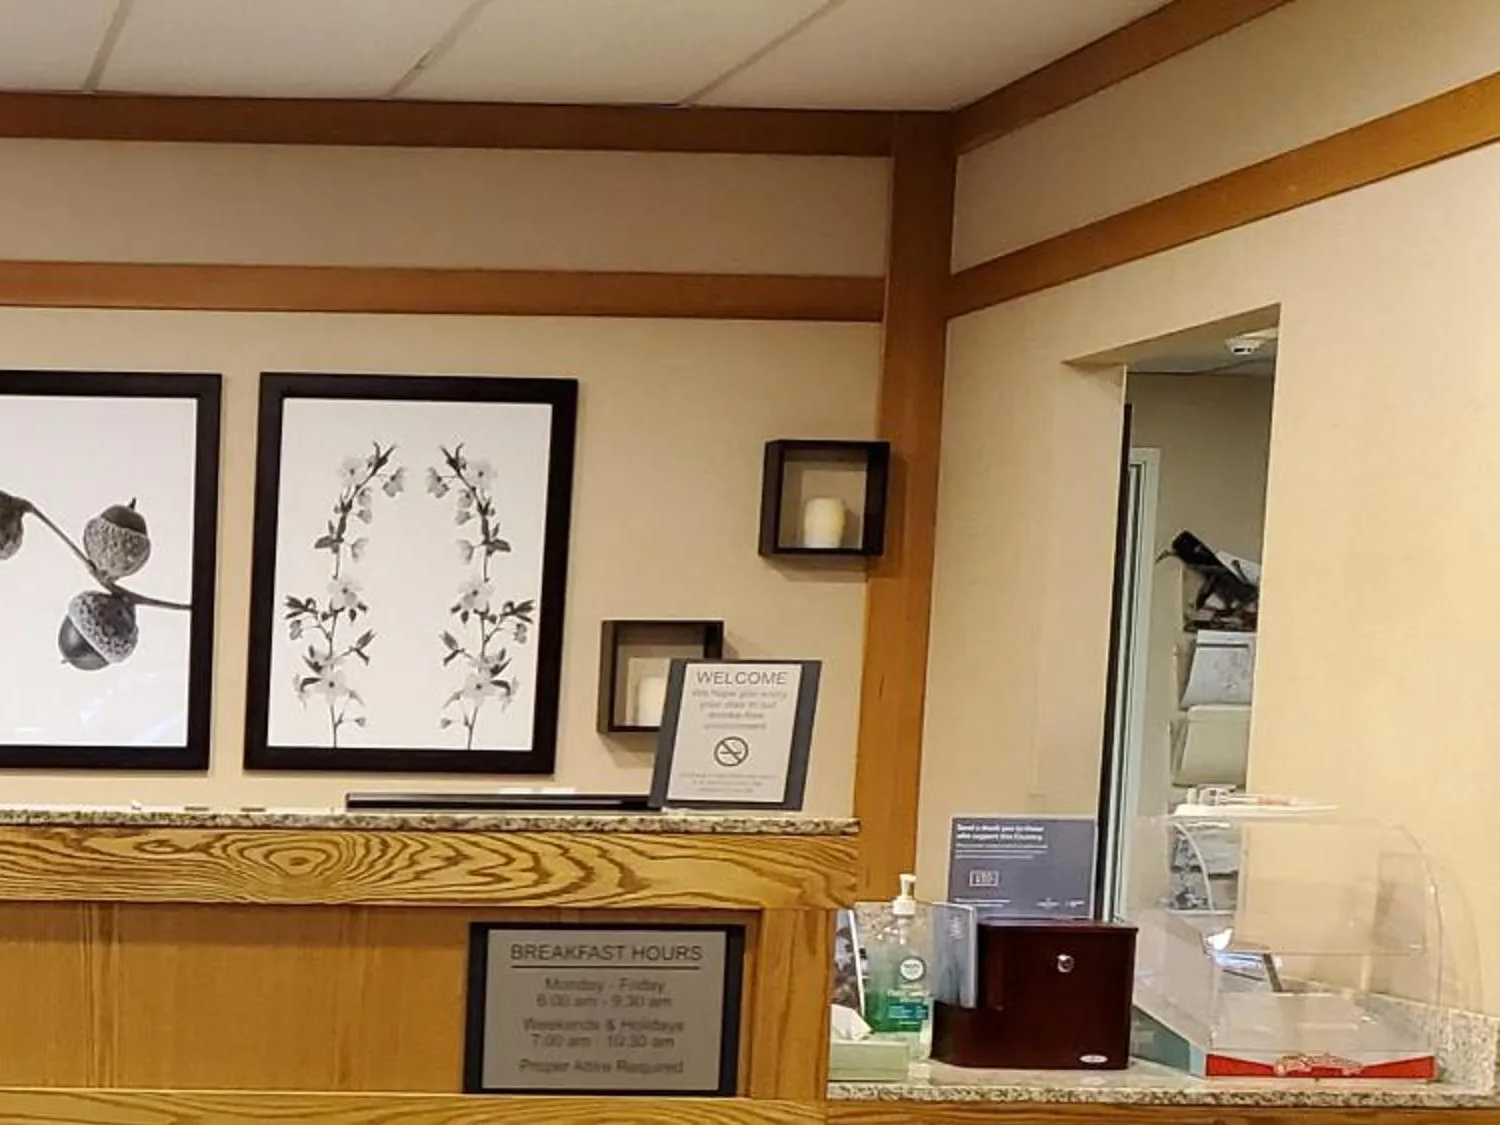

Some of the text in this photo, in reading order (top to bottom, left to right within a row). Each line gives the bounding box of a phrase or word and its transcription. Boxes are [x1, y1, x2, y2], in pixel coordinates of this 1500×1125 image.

[697, 671, 788, 685] WELCOME
[510, 943, 704, 962] BREAKFAST HOURS
[544, 977, 605, 993] Monday
[618, 977, 666, 993] Friday
[573, 997, 598, 1008] am
[648, 997, 673, 1008] am
[523, 1017, 600, 1032] Weekends
[620, 1018, 685, 1034] Holidays
[567, 1036, 592, 1048] am
[651, 1037, 676, 1048] am
[616, 1059, 685, 1074] Required
